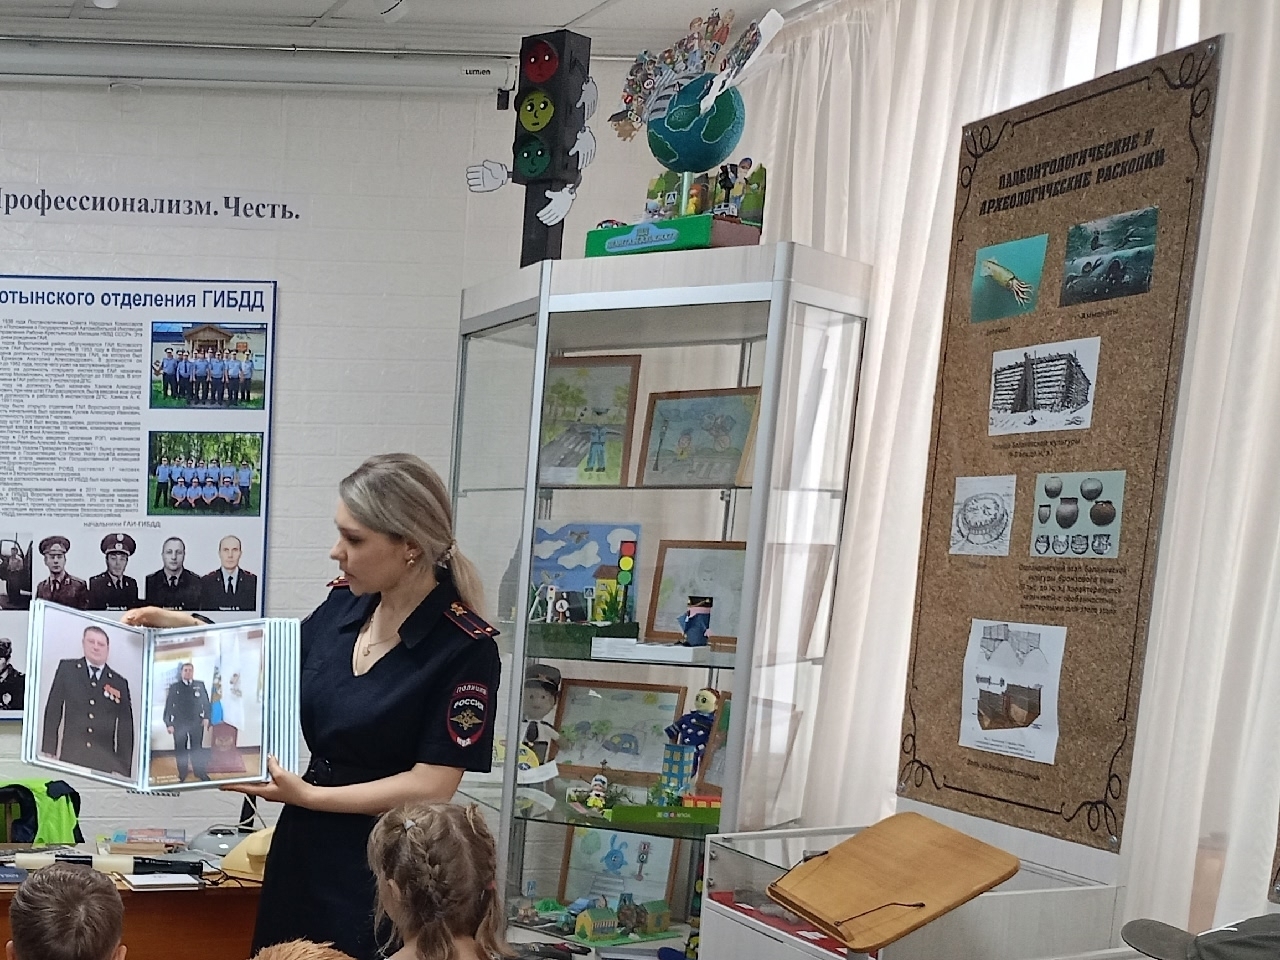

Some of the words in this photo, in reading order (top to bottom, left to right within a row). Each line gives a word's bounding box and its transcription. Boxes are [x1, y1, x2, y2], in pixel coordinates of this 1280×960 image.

[998, 132, 1140, 190] ПАЛЕОНТОЛОГИЧЕСКИЕ
[1142, 128, 1156, 147] И
[978, 171, 1093, 217] АРХЕОЛОГИЧЕСКИЕ
[1095, 148, 1166, 184] РАСКОПКИ
[223, 196, 301, 220] Честь.
[100, 292, 196, 309] отделения
[202, 290, 265, 312] ГИБДД
[453, 698, 484, 711] РОССИЯ
